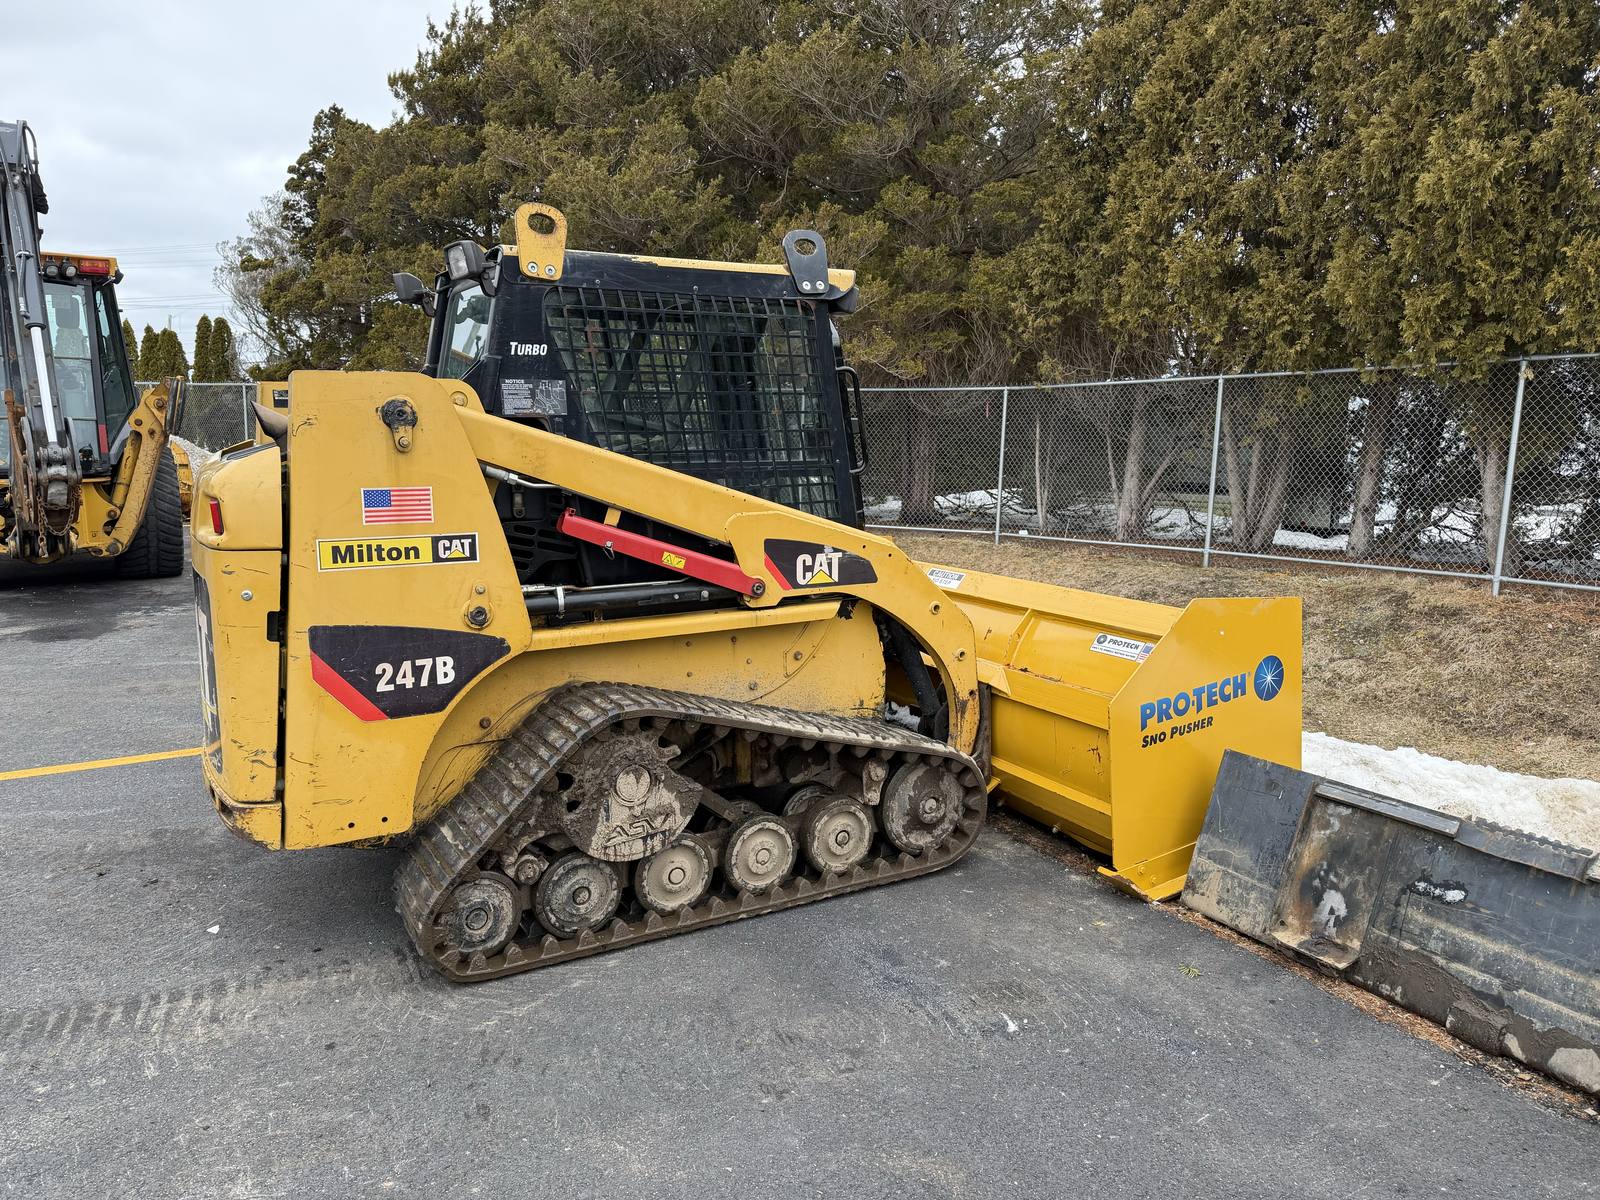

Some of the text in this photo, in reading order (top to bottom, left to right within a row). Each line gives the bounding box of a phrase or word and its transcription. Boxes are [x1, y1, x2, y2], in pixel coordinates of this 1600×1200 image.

[510, 341, 548, 356] TURBO
[331, 539, 472, 564] Milton CAT
[796, 552, 843, 586] CAT
[375, 656, 456, 692] 247B
[1141, 716, 1214, 748] SNO PUSHER
